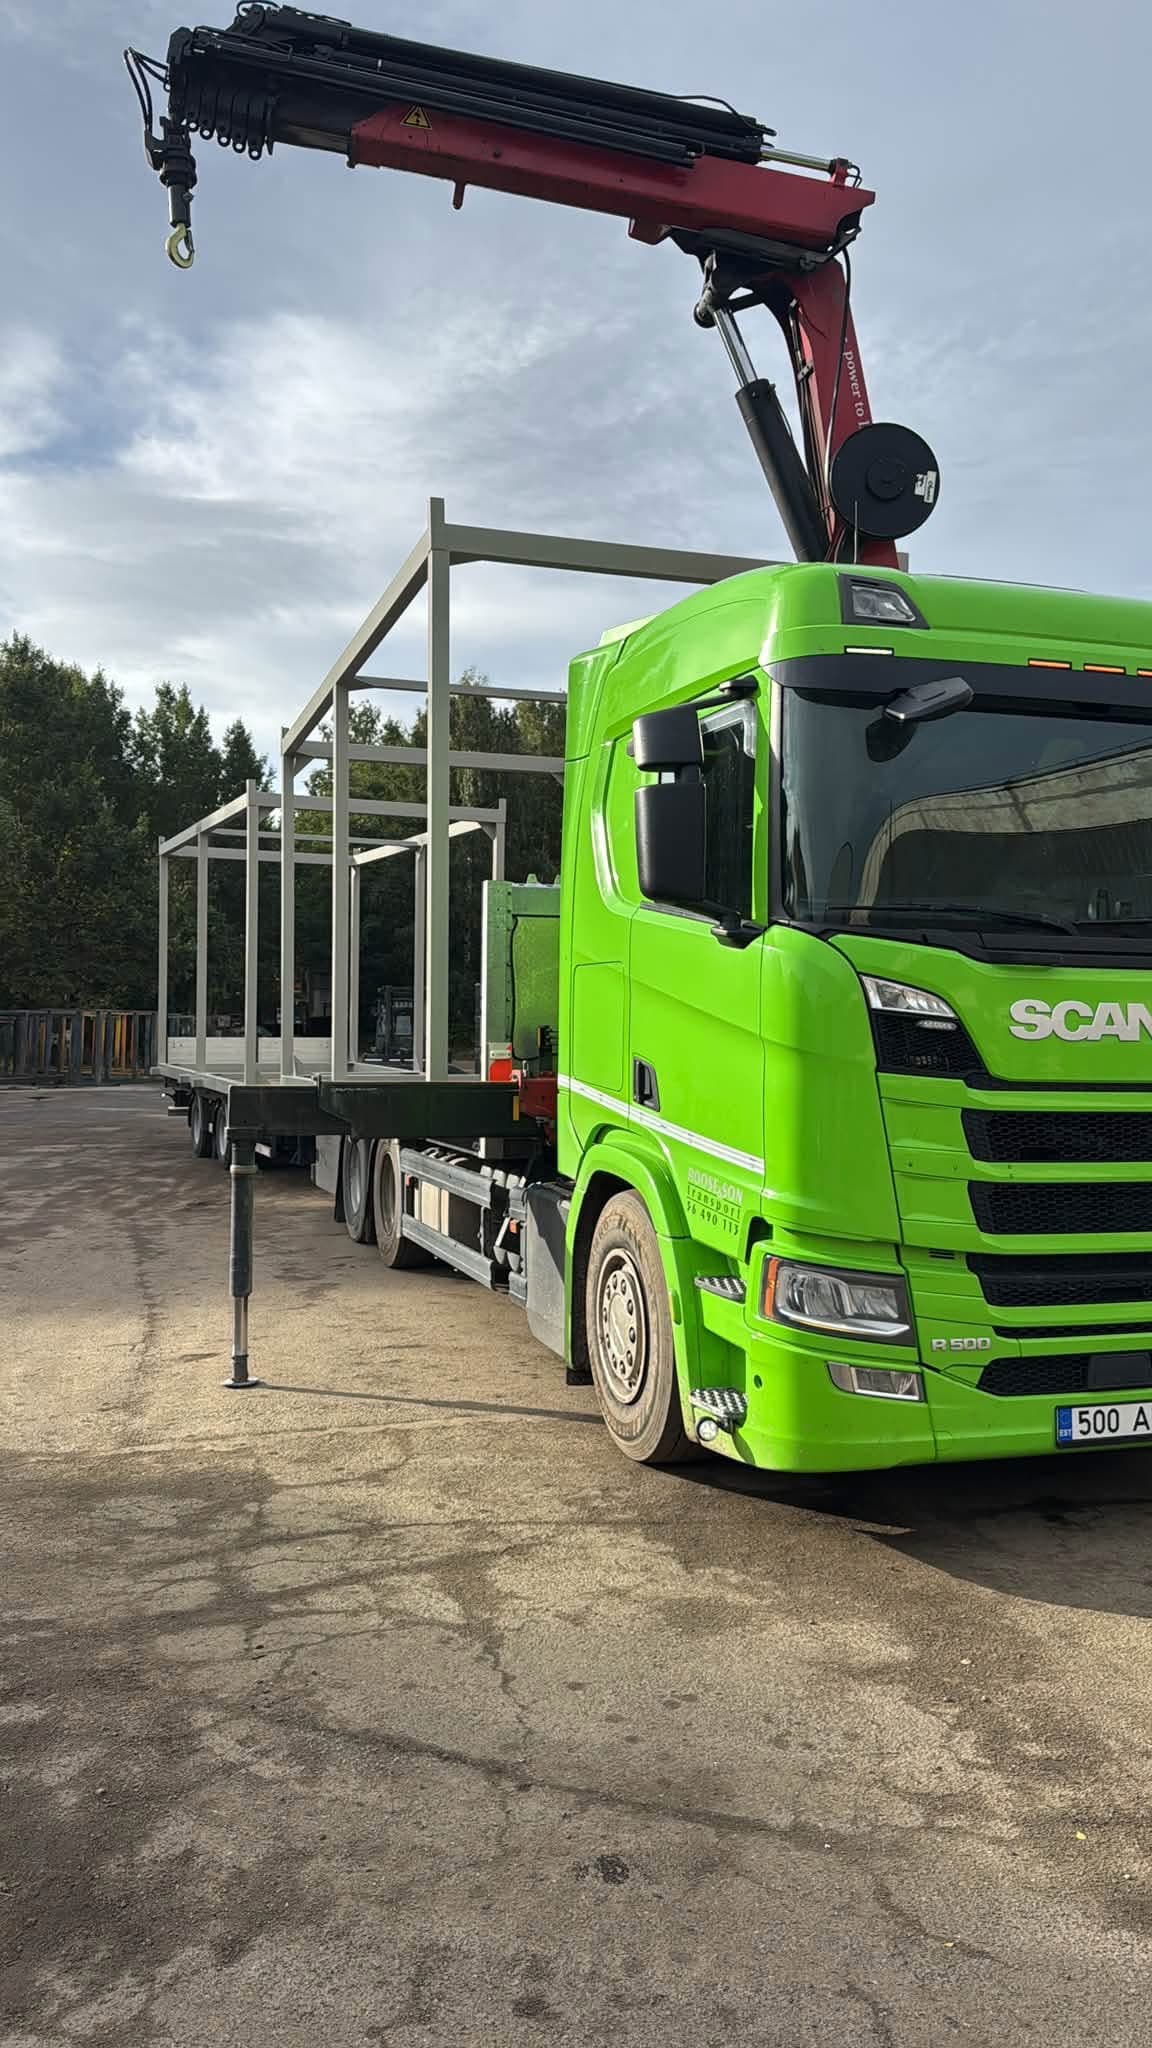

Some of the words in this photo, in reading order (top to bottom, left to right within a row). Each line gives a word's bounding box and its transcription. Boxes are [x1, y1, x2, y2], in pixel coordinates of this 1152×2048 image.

[843, 351, 861, 398] power
[854, 401, 865, 417] to
[931, 1338, 947, 1351] R
[950, 1337, 991, 1351] 500
[1078, 1408, 1119, 1435] 500
[1059, 1429, 1072, 1437] EST
